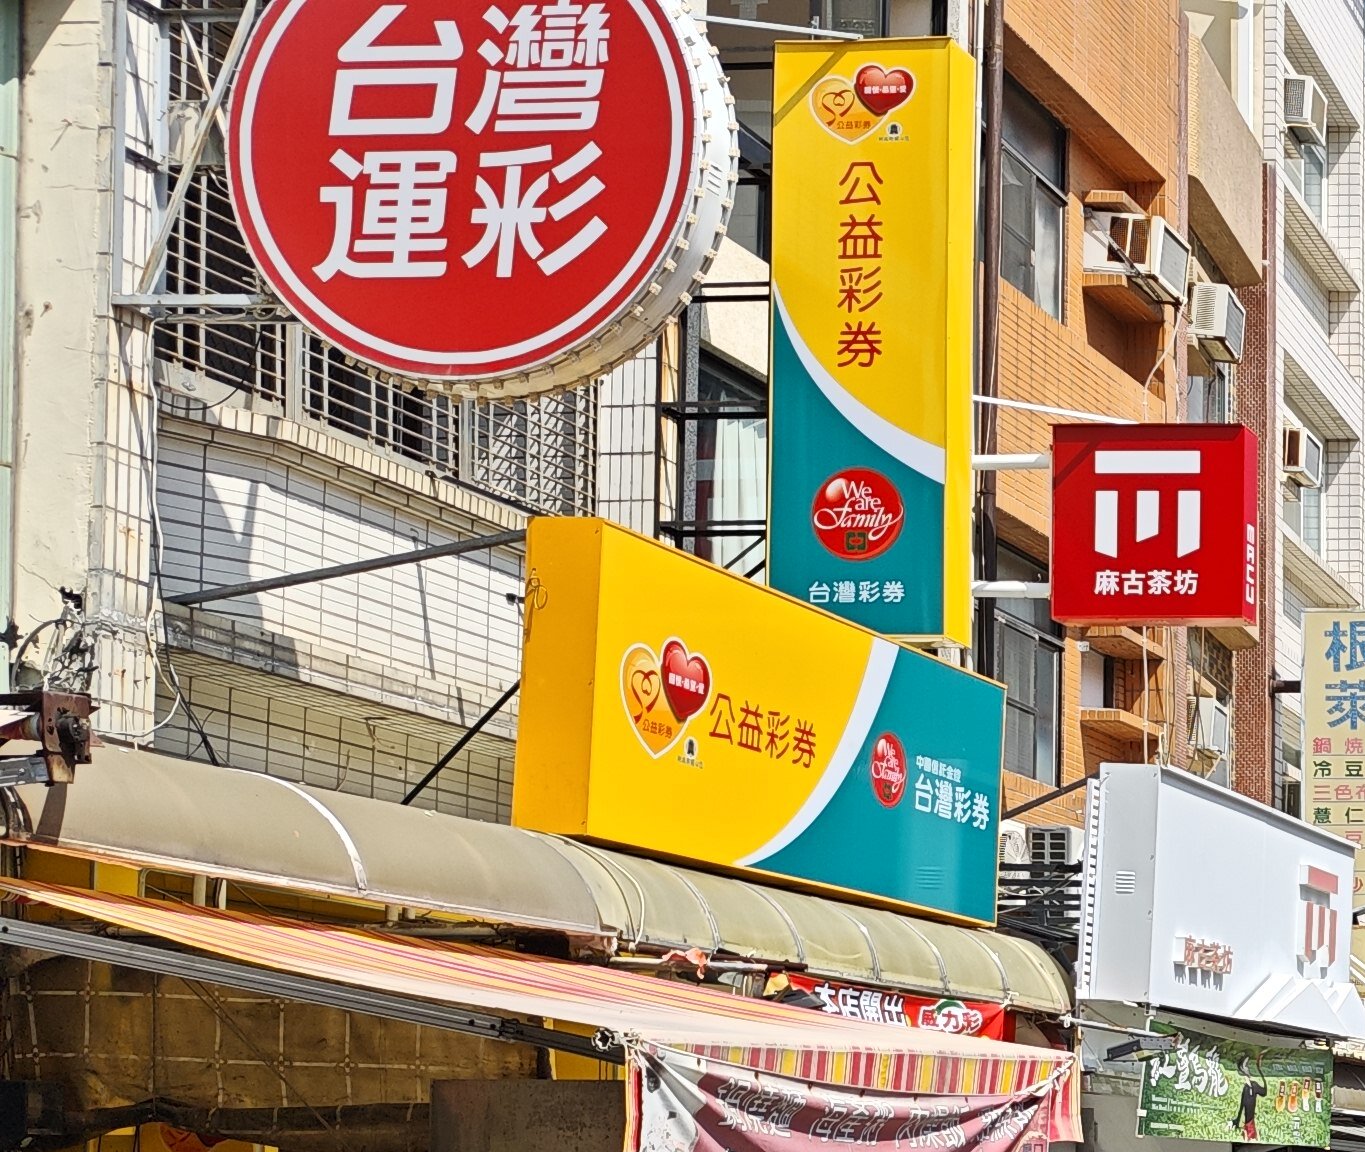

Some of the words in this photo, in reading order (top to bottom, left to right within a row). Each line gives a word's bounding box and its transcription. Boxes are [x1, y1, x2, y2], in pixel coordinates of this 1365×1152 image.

[329, 2, 610, 136] 台灣
[312, 141, 607, 283] 運彩
[838, 161, 884, 368] 公益彩券
[841, 480, 873, 499] We
[855, 497, 881, 512] are
[813, 500, 904, 541] Family
[809, 580, 905, 603] 台灣彩券
[1094, 569, 1199, 596] 麻古茶坊
[709, 692, 817, 768] 公益彩券
[914, 772, 990, 831] 台灣彩券
[815, 983, 907, 1027] 本店開出
[921, 1008, 983, 1034] 威力彩
